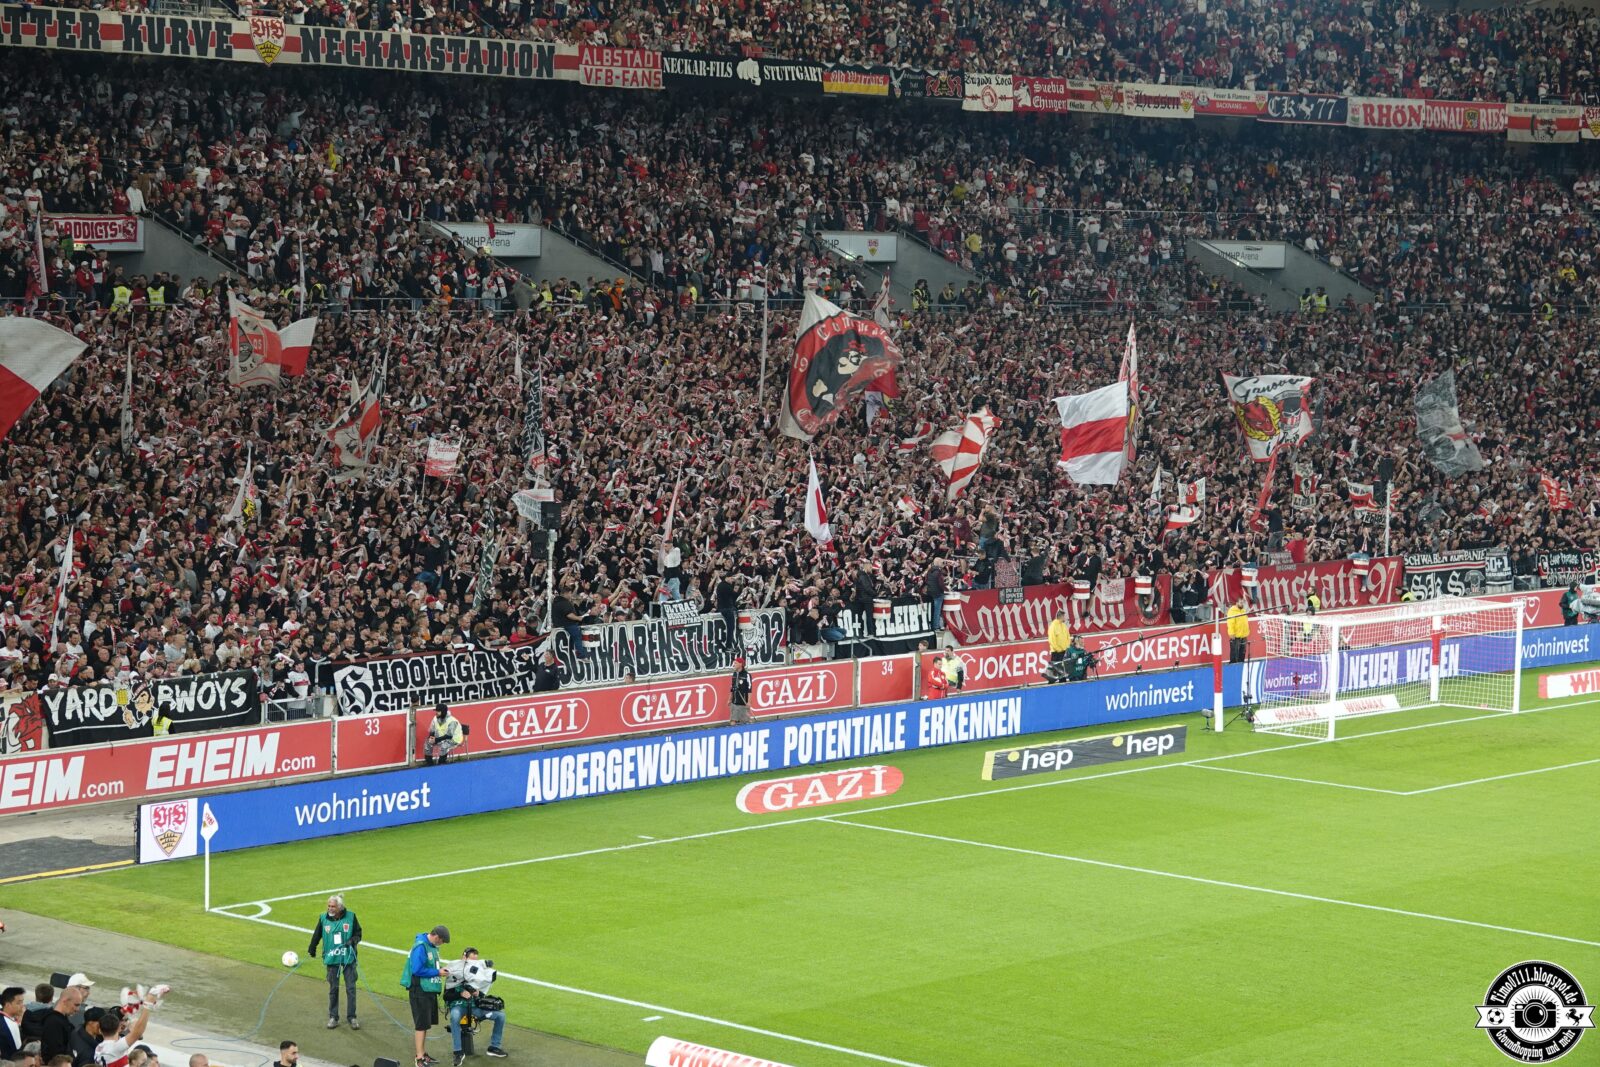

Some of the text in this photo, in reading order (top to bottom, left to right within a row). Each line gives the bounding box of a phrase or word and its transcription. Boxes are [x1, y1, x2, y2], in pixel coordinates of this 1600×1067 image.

[122, 14, 233, 59] KURVE
[300, 27, 556, 78] NECKARSTADION
[582, 49, 662, 68] ALBSTADT
[584, 68, 662, 88] VFB-FANS
[663, 57, 733, 78] NECKAR-FILS
[763, 65, 823, 82] STUTTGART
[1033, 81, 1065, 95] Suebia
[1362, 103, 1423, 128] RHÖN
[1426, 105, 1505, 130] DONAU RIES
[1367, 560, 1398, 605] 97
[664, 600, 697, 613] ULTRAS
[1122, 634, 1213, 664] JOKERSTA
[1521, 634, 1590, 659] wohninvest
[367, 646, 535, 692] HOOLIGANS
[881, 660, 893, 676] 34
[1351, 643, 1460, 688] NEUEN WEEN
[1264, 669, 1318, 689] wohnivest
[45, 677, 247, 726] YARD BWOYS
[1105, 680, 1194, 711] wohninvest
[364, 718, 380, 736] 33
[525, 697, 1022, 804] AUßERGEWÖHNLICHE POTENTIALE ERKENNEN
[1126, 733, 1174, 755] hep
[1021, 749, 1073, 771] hep
[294, 782, 431, 827] wohninvest
